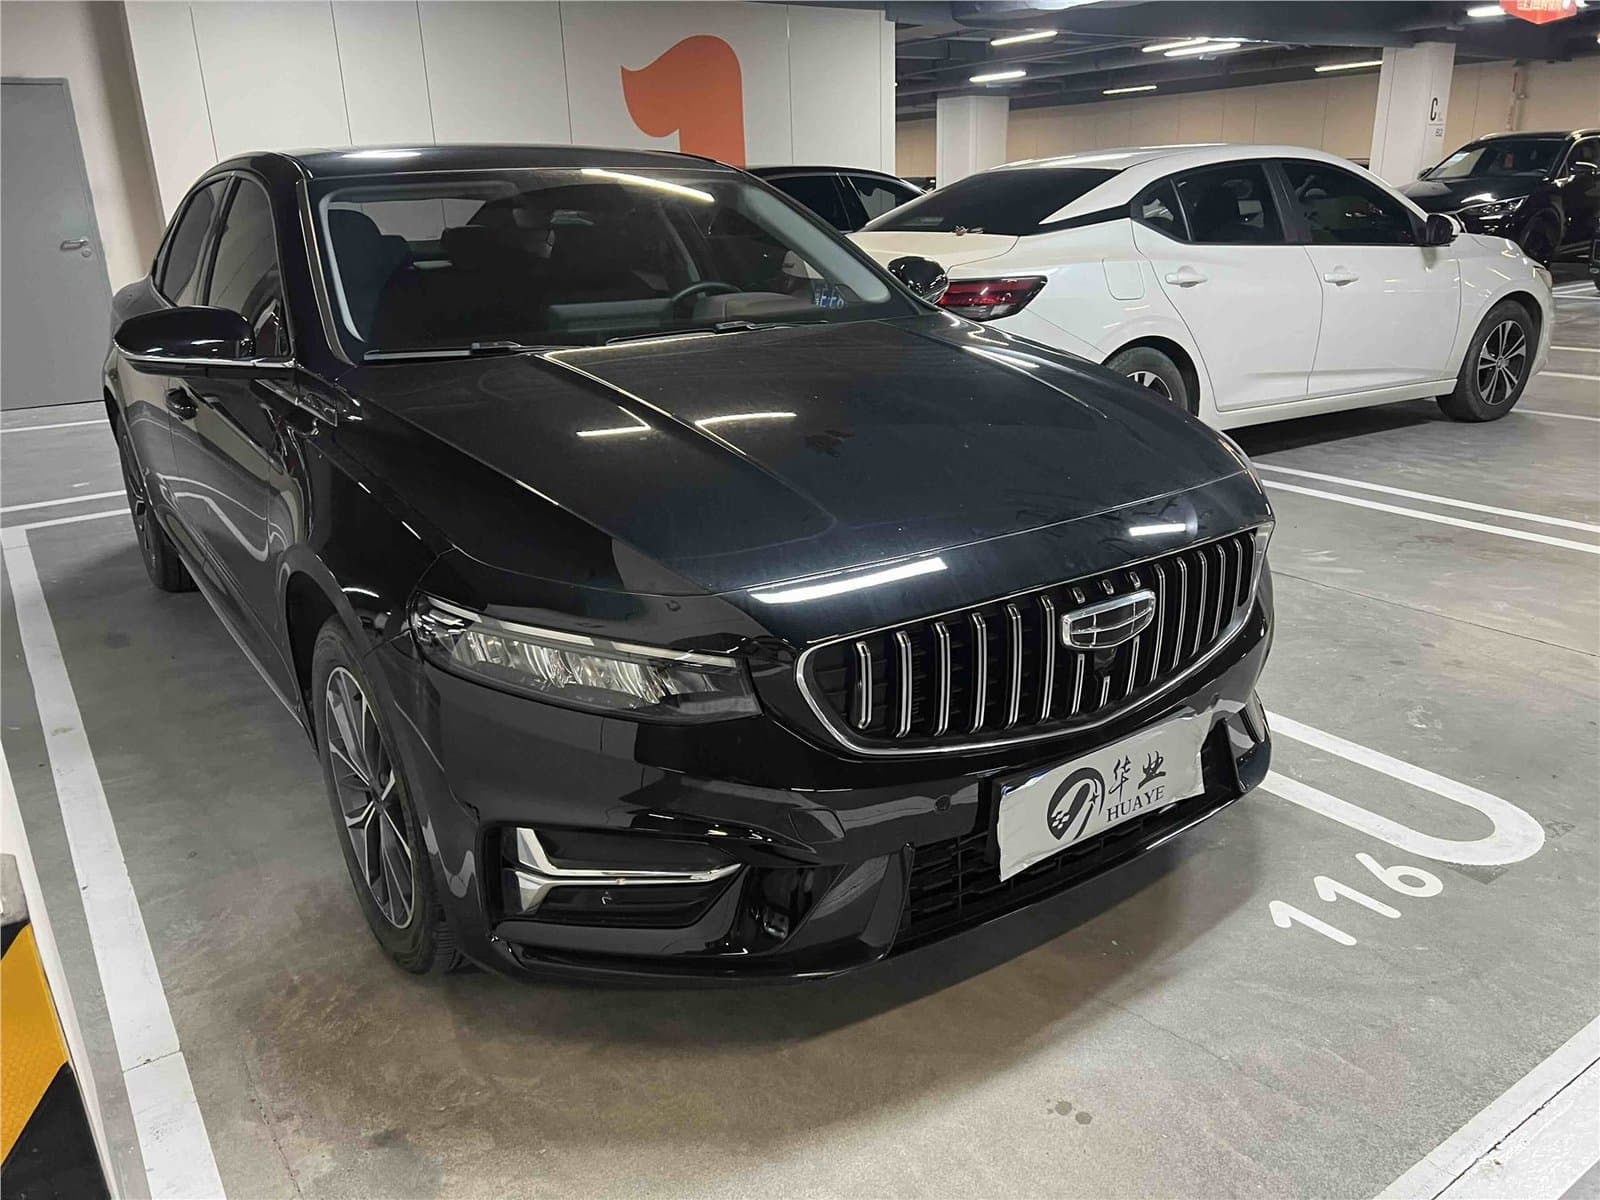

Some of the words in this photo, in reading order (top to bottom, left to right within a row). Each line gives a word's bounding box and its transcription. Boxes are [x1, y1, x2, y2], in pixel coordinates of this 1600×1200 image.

[1430, 97, 1439, 121] C
[1109, 750, 1167, 800] 华业
[1106, 785, 1166, 823] HUAYE
[1268, 852, 1444, 946] 116
